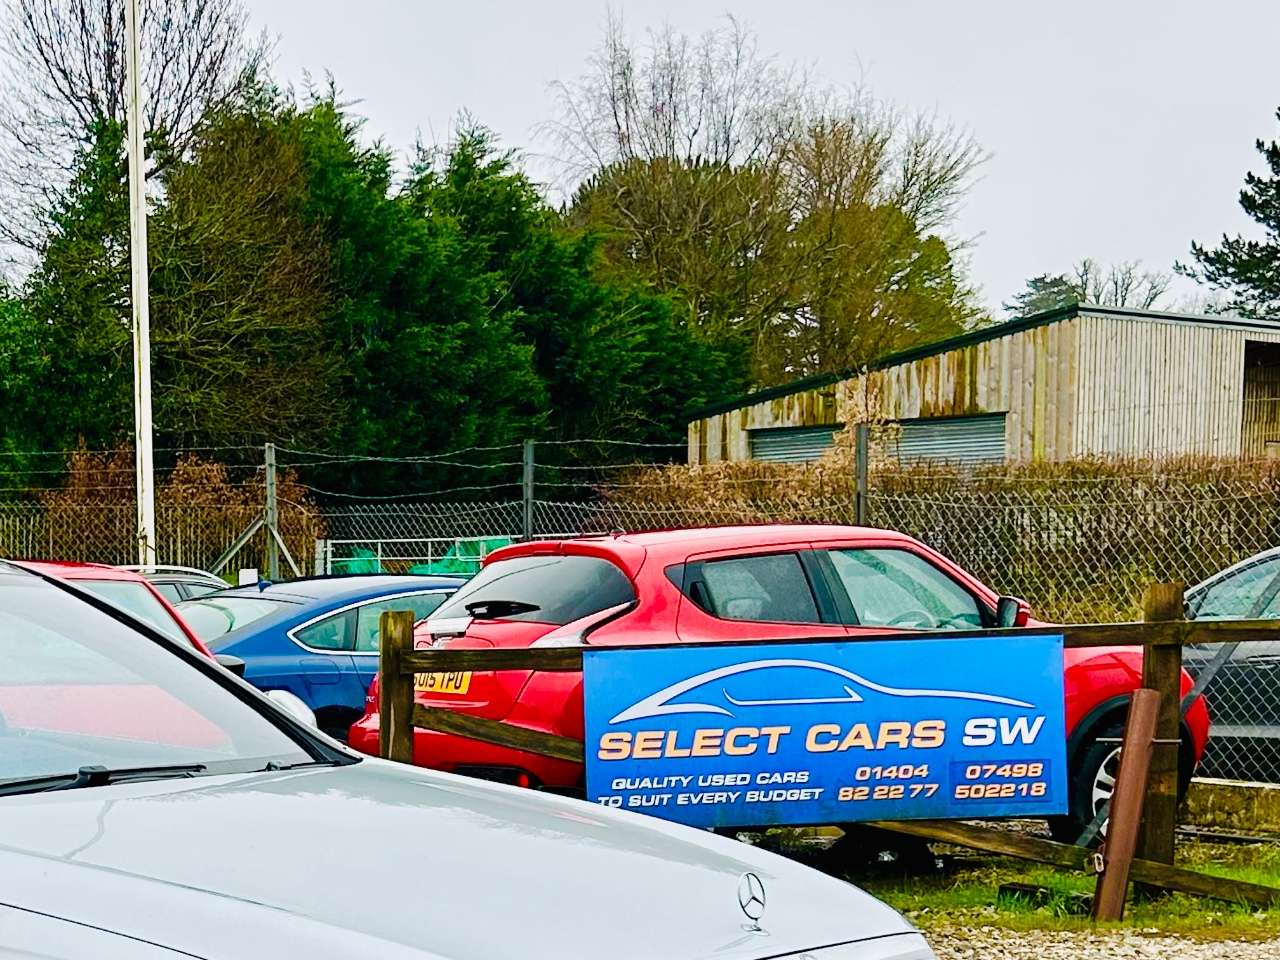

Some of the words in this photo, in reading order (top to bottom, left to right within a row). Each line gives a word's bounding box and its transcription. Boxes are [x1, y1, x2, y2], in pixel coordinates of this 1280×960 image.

[598, 725, 792, 761] SELECT
[805, 719, 946, 752] CARS
[962, 715, 1046, 747] SW
[855, 764, 929, 781] 01404
[965, 762, 1044, 780] 07498
[611, 775, 694, 790] QUALITY
[698, 773, 751, 787] USED
[756, 771, 810, 785] CARS
[597, 796, 623, 808] TO
[628, 793, 673, 807] SUIT
[677, 791, 742, 805] EVERY
[745, 788, 825, 802] BUDGET
[838, 786, 870, 801] 82
[872, 785, 905, 800] 22
[908, 783, 939, 799] 77
[954, 782, 1046, 799] 502218
